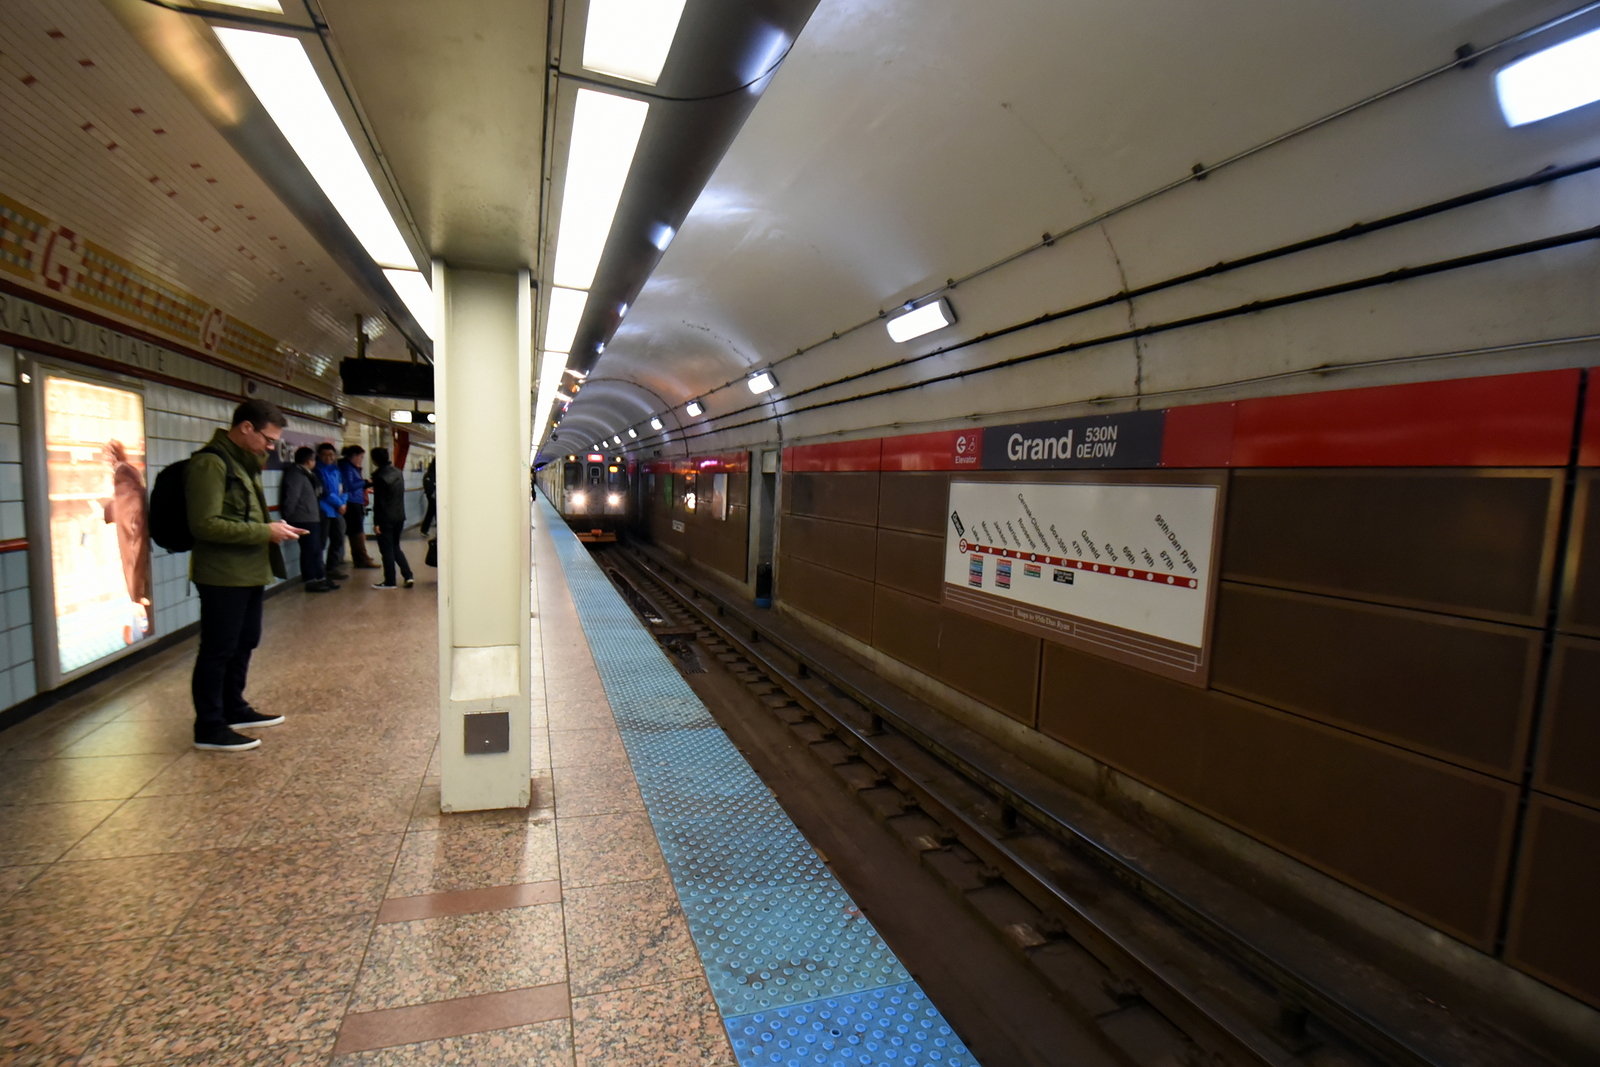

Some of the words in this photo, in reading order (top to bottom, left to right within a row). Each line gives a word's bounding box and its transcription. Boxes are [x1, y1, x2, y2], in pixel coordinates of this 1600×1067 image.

[97, 328, 165, 373] STATE
[1007, 429, 1074, 462] Grand
[1085, 425, 1118, 443] 530N
[955, 456, 977, 465] Elevator
[981, 520, 994, 545] Monroe
[993, 520, 1008, 546] Jackson
[1006, 520, 1021, 548] Harrison
[1018, 493, 1051, 552] Cermak-Chinatown
[1018, 517, 1037, 550] Roosevelt
[1049, 524, 1068, 555] Sox-35th
[1071, 540, 1083, 557] 47th
[1081, 529, 1101, 560] Garfield
[1154, 513, 1181, 552] 95th/Dan
[1179, 549, 1198, 574] Ryan
[1104, 543, 1118, 563] 63rd
[1122, 545, 1136, 565] 69th
[1141, 547, 1155, 568] 79th
[1159, 550, 1175, 571] 87th
